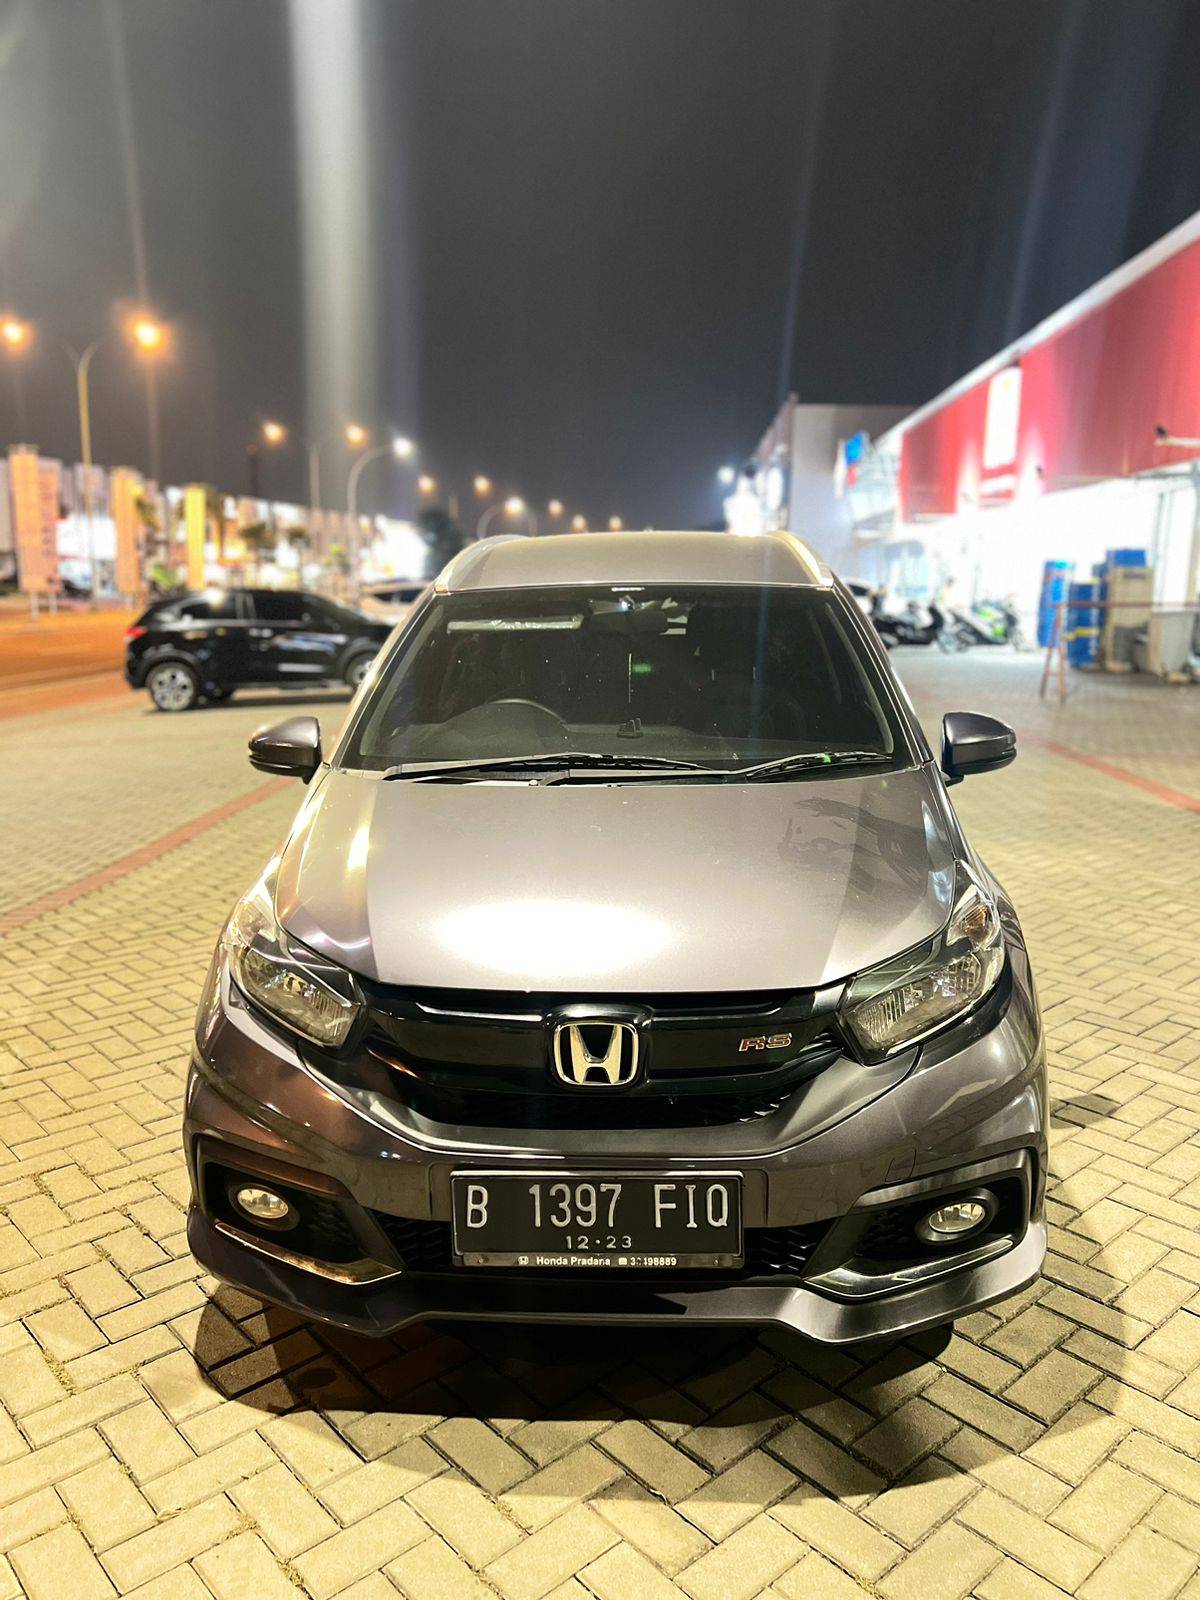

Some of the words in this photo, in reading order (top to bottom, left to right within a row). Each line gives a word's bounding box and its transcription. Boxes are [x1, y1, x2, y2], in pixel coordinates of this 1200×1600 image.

[738, 1033, 792, 1052] RS
[466, 1185, 488, 1228] B
[529, 1183, 622, 1228] 1397
[654, 1183, 727, 1228] FIQ
[536, 1256, 568, 1265] Honda
[570, 1256, 610, 1265] Pradana
